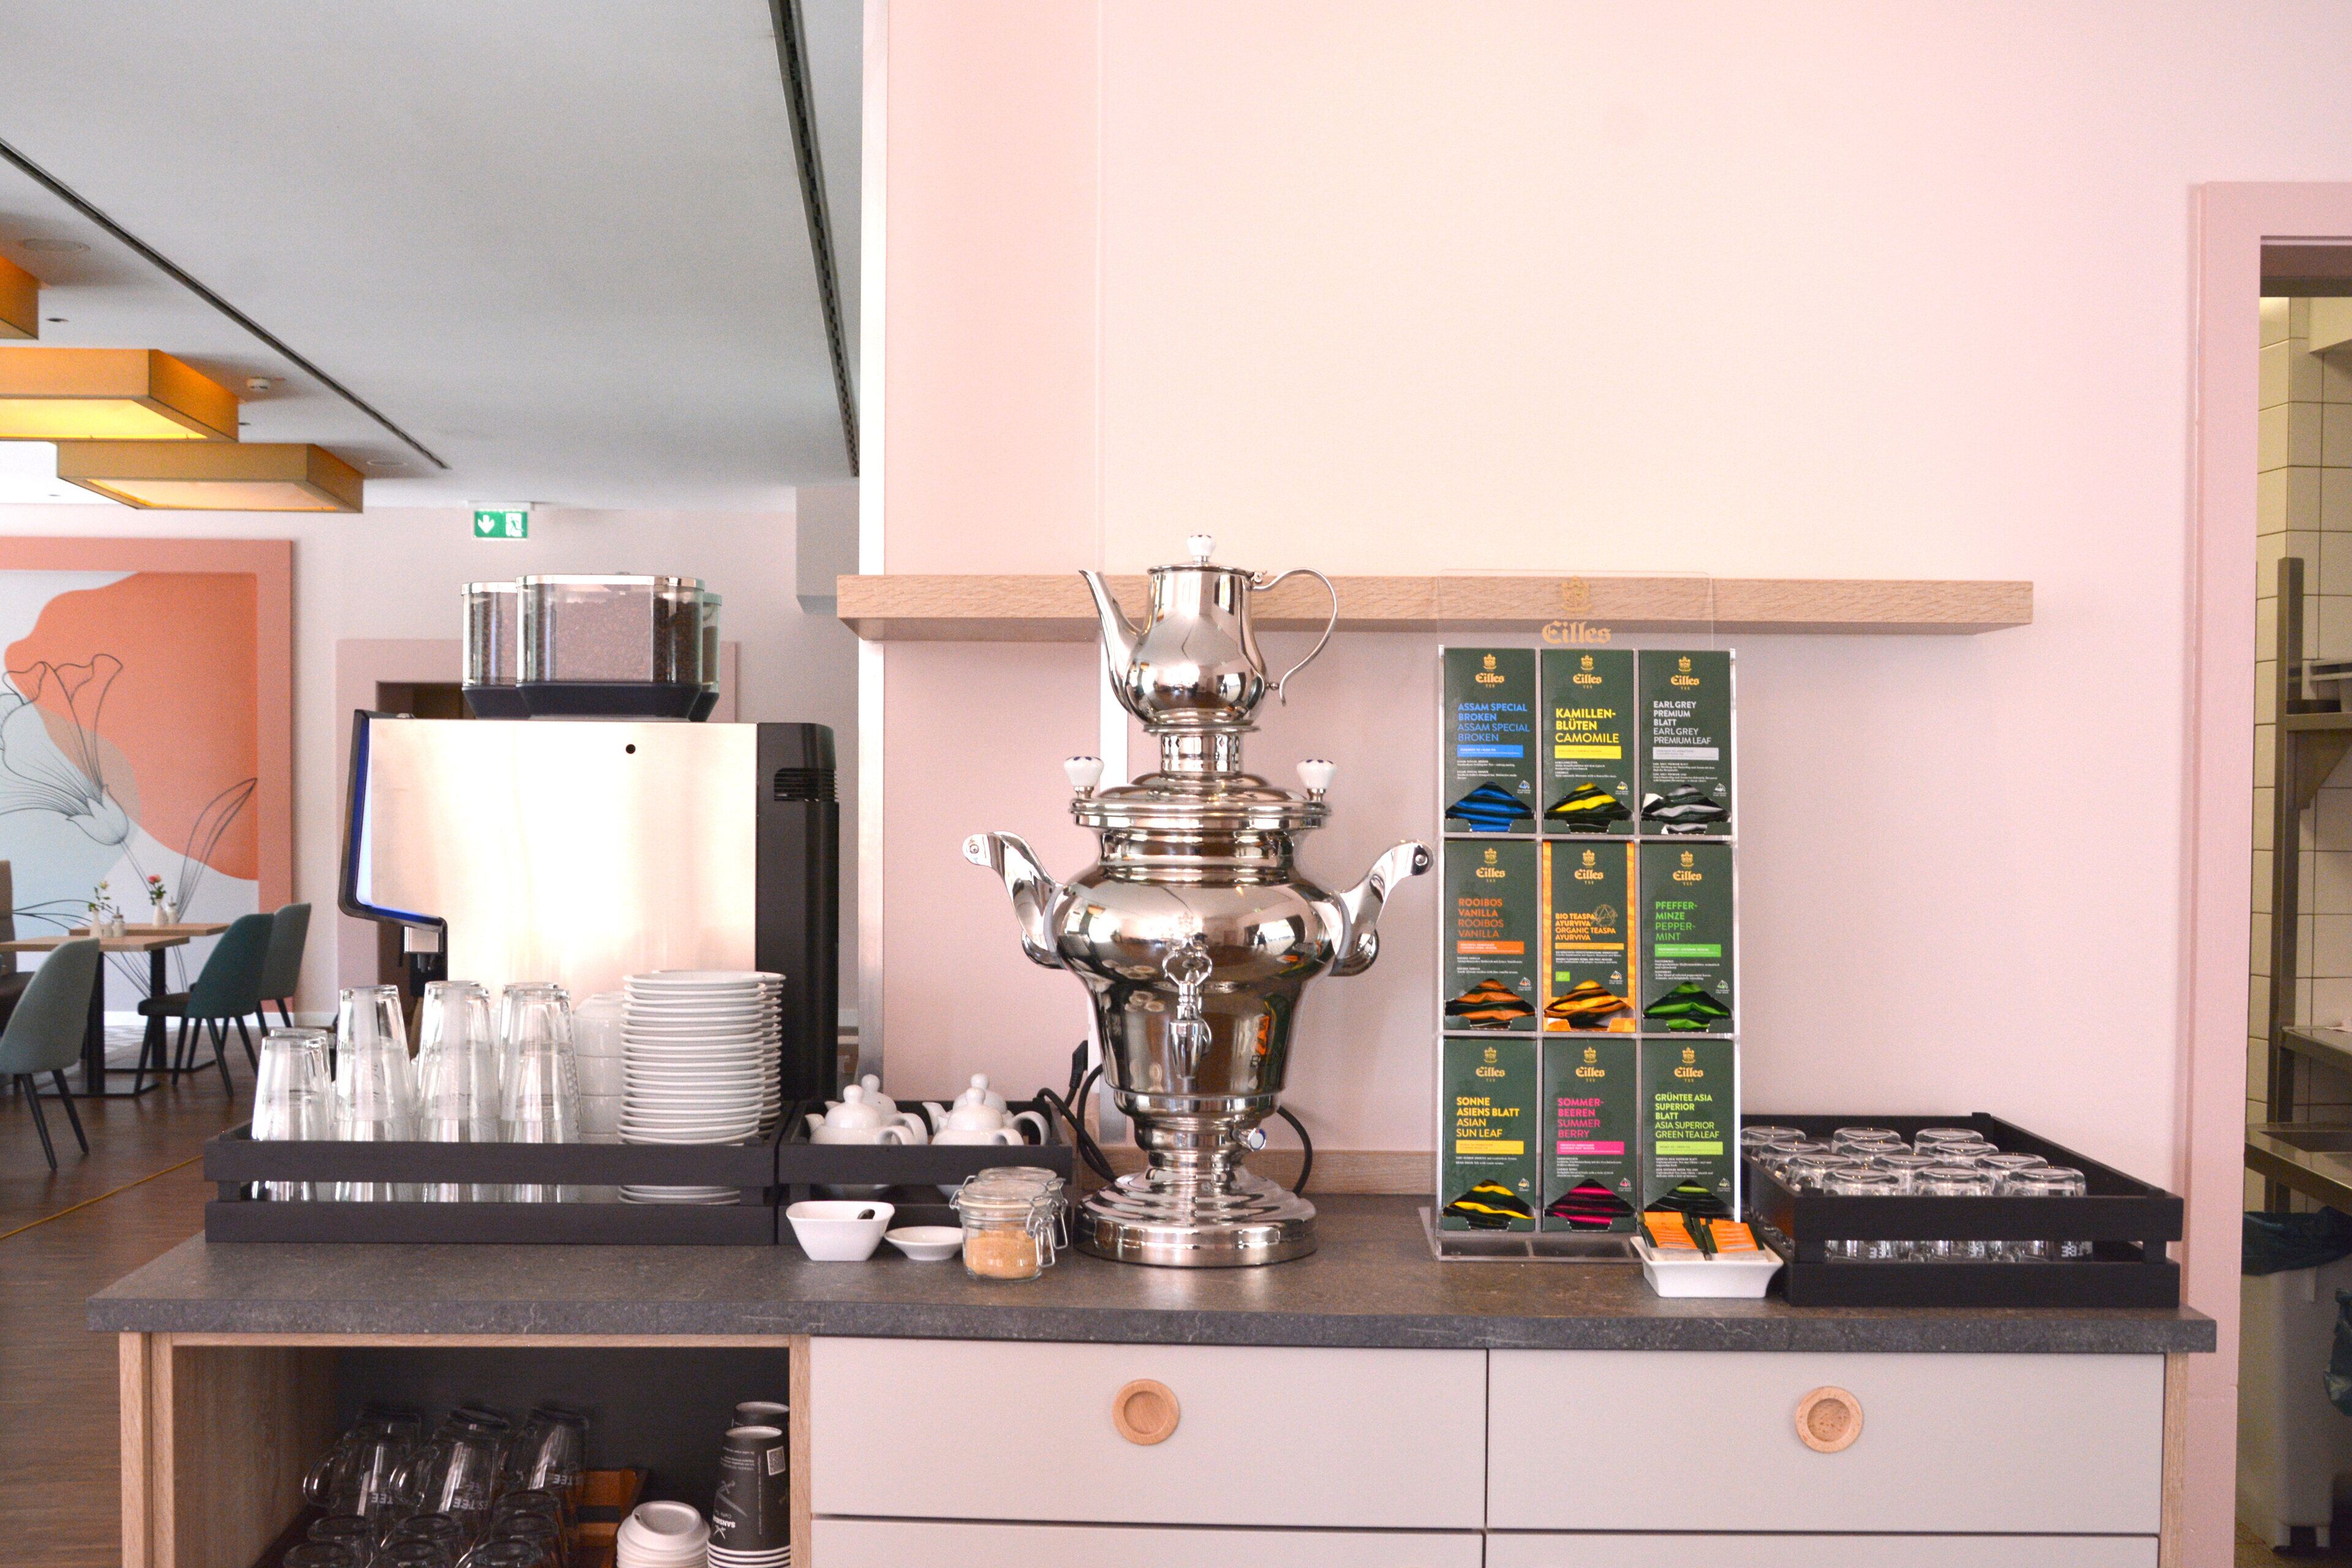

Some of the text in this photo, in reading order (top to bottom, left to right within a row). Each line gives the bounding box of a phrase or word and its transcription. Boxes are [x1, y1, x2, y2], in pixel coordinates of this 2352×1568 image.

[1542, 620, 1611, 644] Eilles
[1475, 673, 1505, 683] Eilles
[1573, 674, 1602, 684] Eilles
[1670, 675, 1700, 686] Eilles
[1491, 703, 1527, 712] SPECIAL
[1556, 709, 1616, 718] KAMILLEN-
[1491, 723, 1529, 732] SPECIAL
[1556, 718, 1597, 730] BLÜTEN
[1555, 733, 1619, 743] CAMOMILE
[1476, 867, 1506, 878] Eilles
[1575, 869, 1604, 880] Eilles
[1673, 870, 1702, 881] Eilles
[1458, 919, 1504, 928] ROOIBOS
[1476, 1066, 1506, 1077] Eilles
[1575, 1066, 1605, 1077] Eilles
[1674, 1066, 1703, 1077] Eilles
[1457, 1097, 1490, 1106] SONNE
[1655, 1093, 1693, 1101] GRÜNTEE
[1558, 1098, 1604, 1107] SOMMER-
[1457, 1108, 1520, 1117] ASIENS BLATT
[1558, 1109, 1596, 1117] BEEREN
[1558, 1119, 1600, 1128] SUMMER
[1456, 1129, 1478, 1137] SUN
[1558, 1129, 1589, 1138] BERRY
[453, 1498, 475, 1510] TEE
